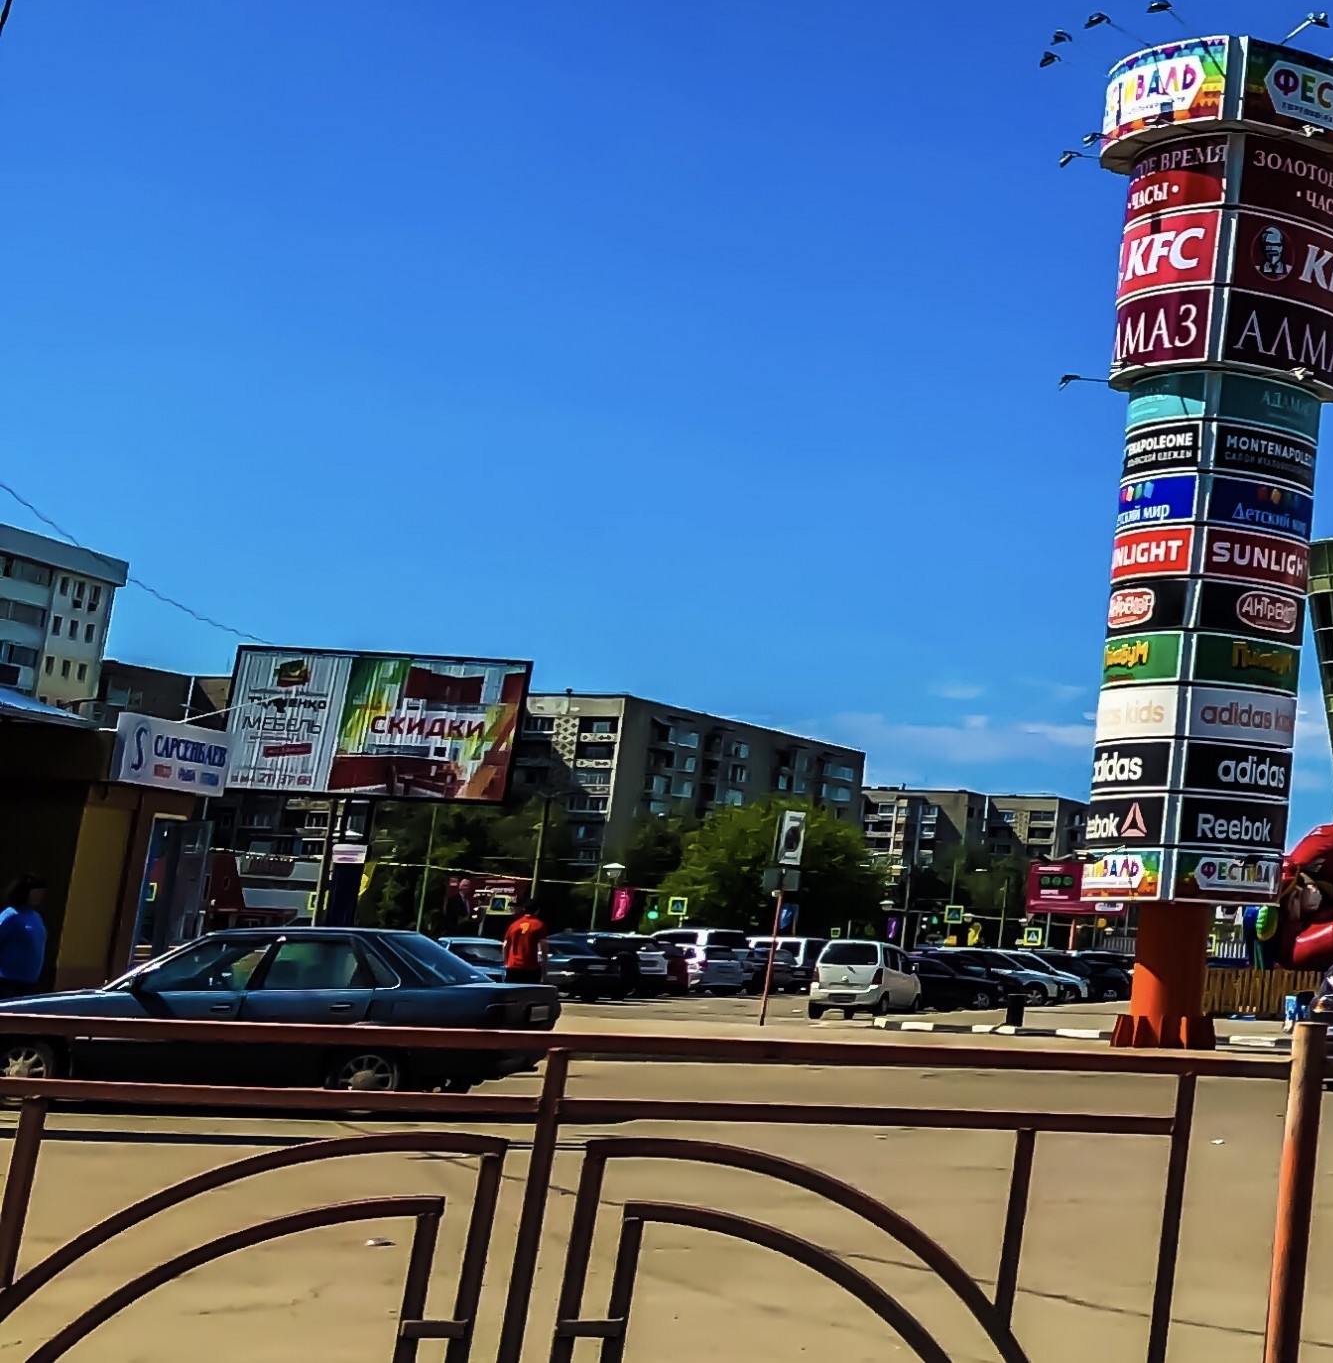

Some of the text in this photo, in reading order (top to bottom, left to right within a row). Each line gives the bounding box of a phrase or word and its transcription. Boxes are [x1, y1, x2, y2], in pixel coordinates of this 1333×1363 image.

[1160, 144, 1228, 171] ВРЕМЯ
[1131, 182, 1169, 209] ЧАСЫ
[1124, 228, 1206, 282] KFC
[1232, 502, 1290, 528] Детский
[1111, 540, 1184, 570] NLIGHT
[242, 715, 322, 735] МЕБЕЛЬ
[370, 715, 486, 741] СКИДКИ
[1200, 701, 1271, 729] adidas
[1218, 756, 1286, 789] adidas
[1196, 812, 1272, 842] Reebok
